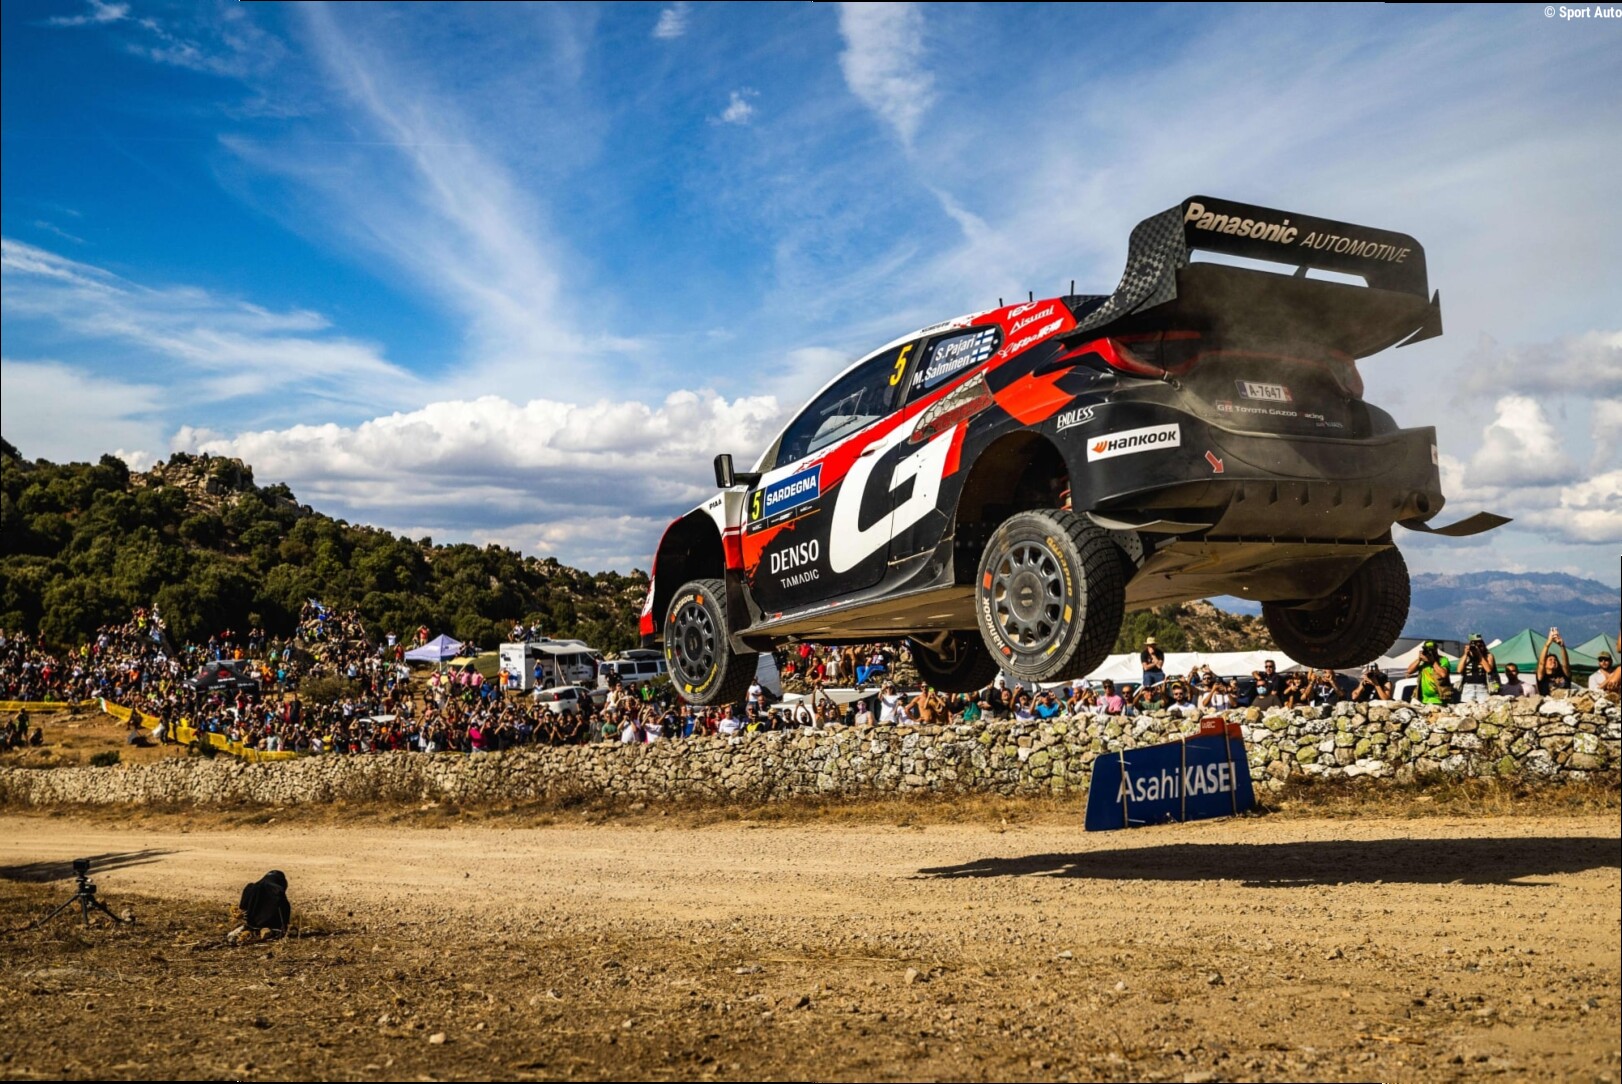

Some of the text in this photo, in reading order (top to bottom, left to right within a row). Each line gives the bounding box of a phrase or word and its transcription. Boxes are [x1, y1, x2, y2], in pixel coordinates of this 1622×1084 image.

[1184, 202, 1411, 263] Panasonic AUTOMOTIVE
[889, 344, 913, 386] 5
[1249, 384, 1281, 398] A-7647
[1057, 406, 1095, 430] ENDLESS
[766, 474, 817, 506] SARDEGNA
[751, 491, 762, 520] 5
[770, 539, 819, 574] DENSO
[780, 568, 820, 589] TAMADIC
